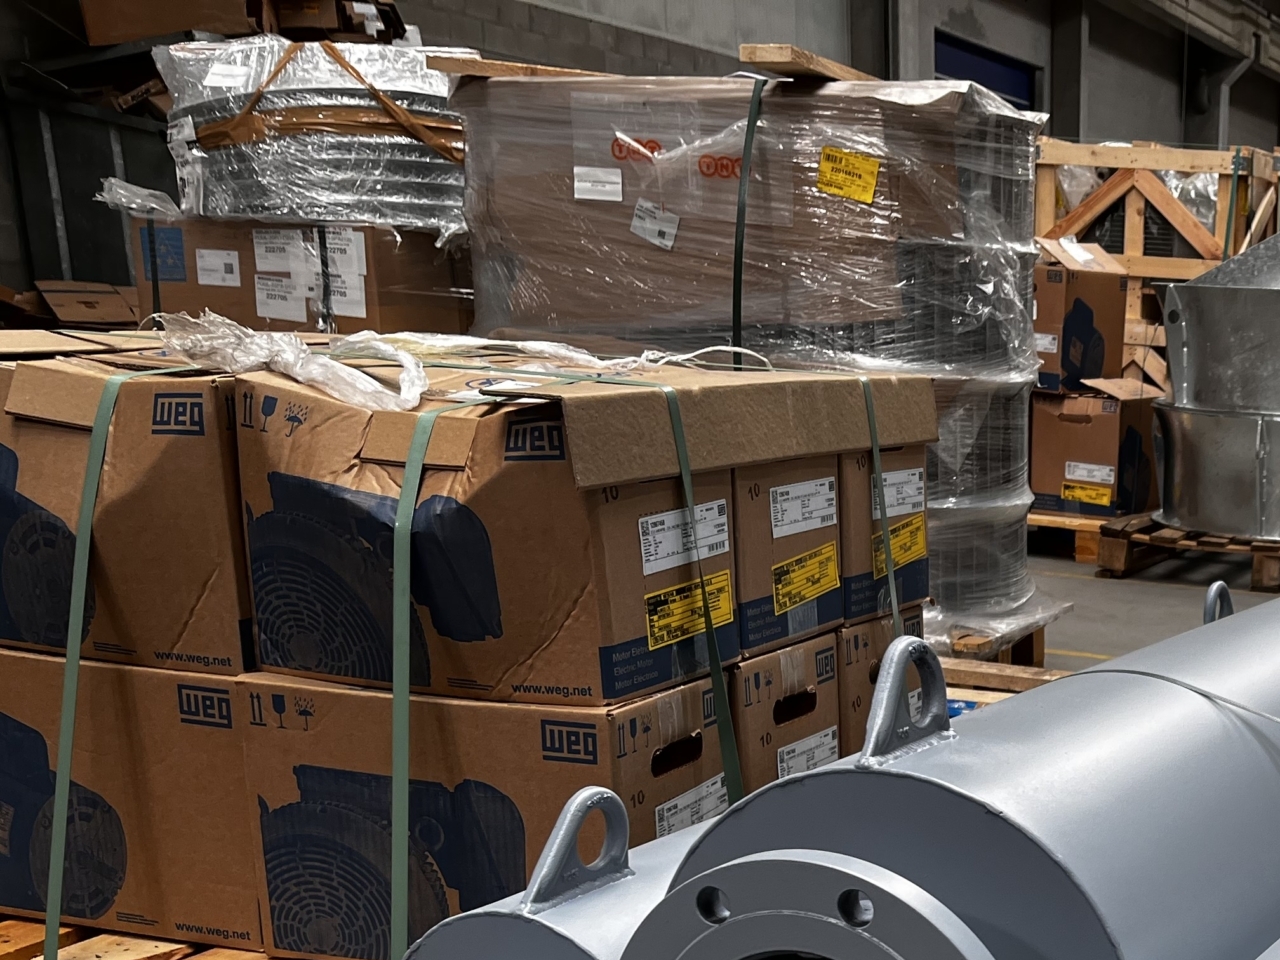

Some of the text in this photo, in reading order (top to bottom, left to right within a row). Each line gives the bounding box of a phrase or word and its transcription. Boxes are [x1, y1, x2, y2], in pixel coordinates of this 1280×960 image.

[698, 155, 751, 178] TN
[328, 247, 347, 255] 22705
[856, 454, 867, 471] 10
[602, 485, 619, 503] 10
[748, 483, 760, 501] 10
[154, 651, 233, 667] www.weg.net
[612, 651, 631, 663] Motor
[614, 658, 654, 676] Electric Motor
[511, 684, 593, 698] www.weg.net
[615, 679, 633, 690] Motor
[760, 732, 772, 747] 10
[630, 790, 645, 808] 10
[175, 922, 252, 941] www.weg.net
